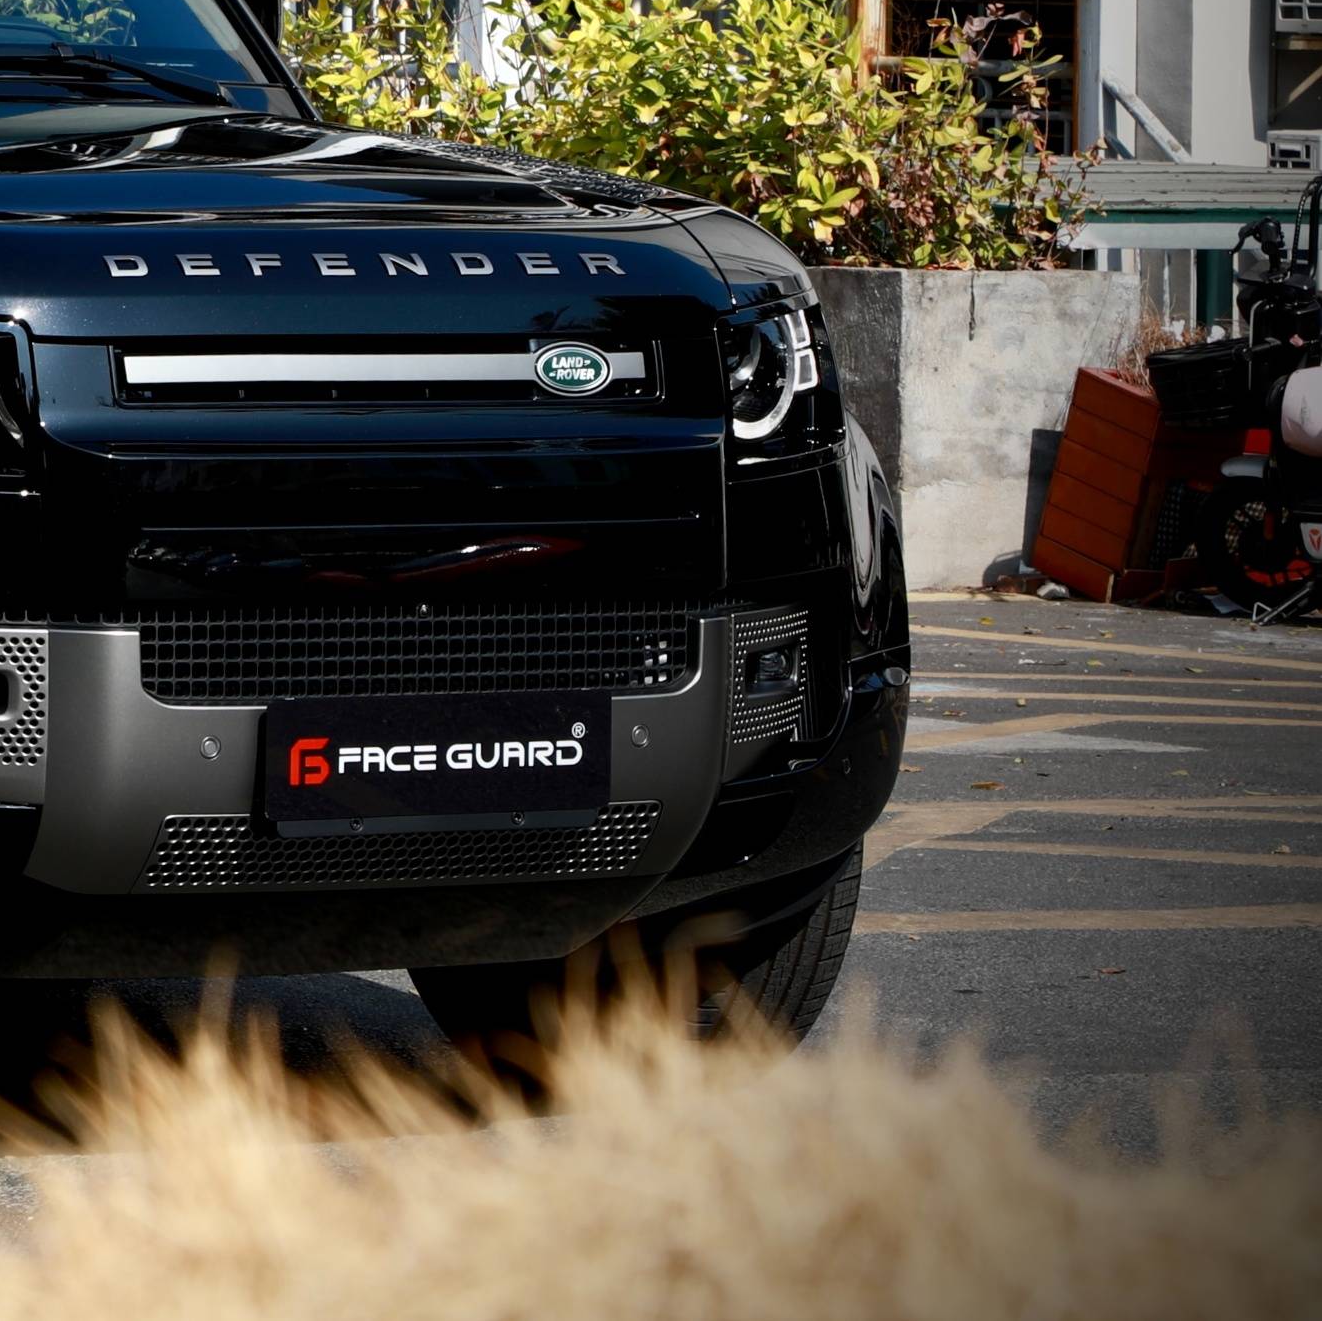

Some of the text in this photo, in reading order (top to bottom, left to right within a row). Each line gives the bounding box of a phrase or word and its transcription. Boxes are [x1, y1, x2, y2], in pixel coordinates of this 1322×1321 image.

[103, 252, 627, 277] DEFENDER
[551, 356, 583, 369] LAND
[556, 368, 595, 380] ROVER
[338, 745, 437, 774] FACE
